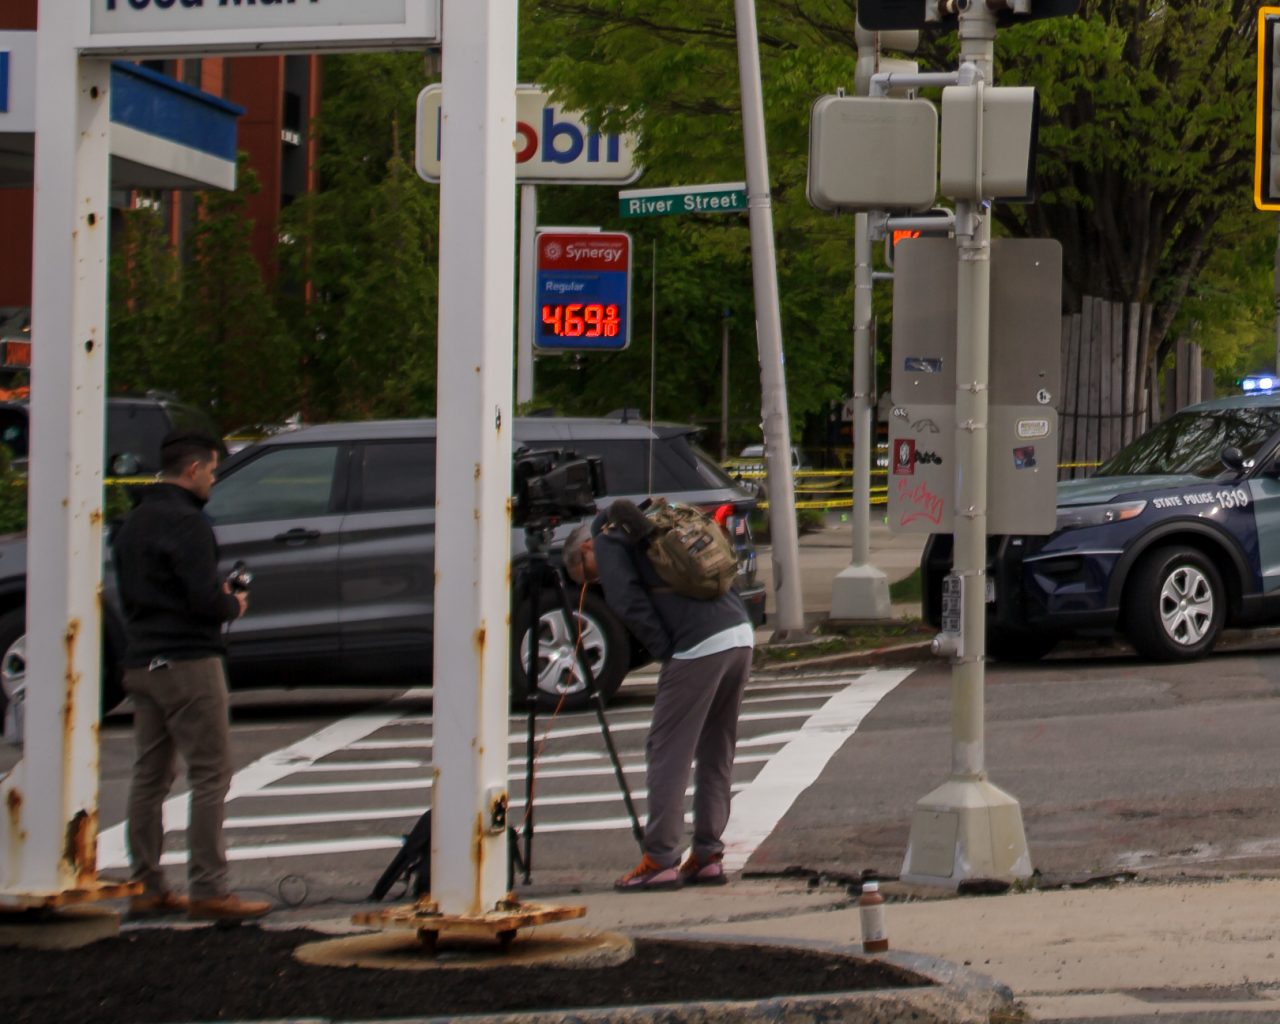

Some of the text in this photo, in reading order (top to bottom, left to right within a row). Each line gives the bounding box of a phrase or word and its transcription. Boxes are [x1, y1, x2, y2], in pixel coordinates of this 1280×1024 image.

[436, 107, 620, 164] obil
[629, 193, 738, 215] River Street
[565, 244, 623, 262] Synergy
[545, 281, 585, 294] Regular
[1153, 489, 1249, 510] STATE POLICE 1319
